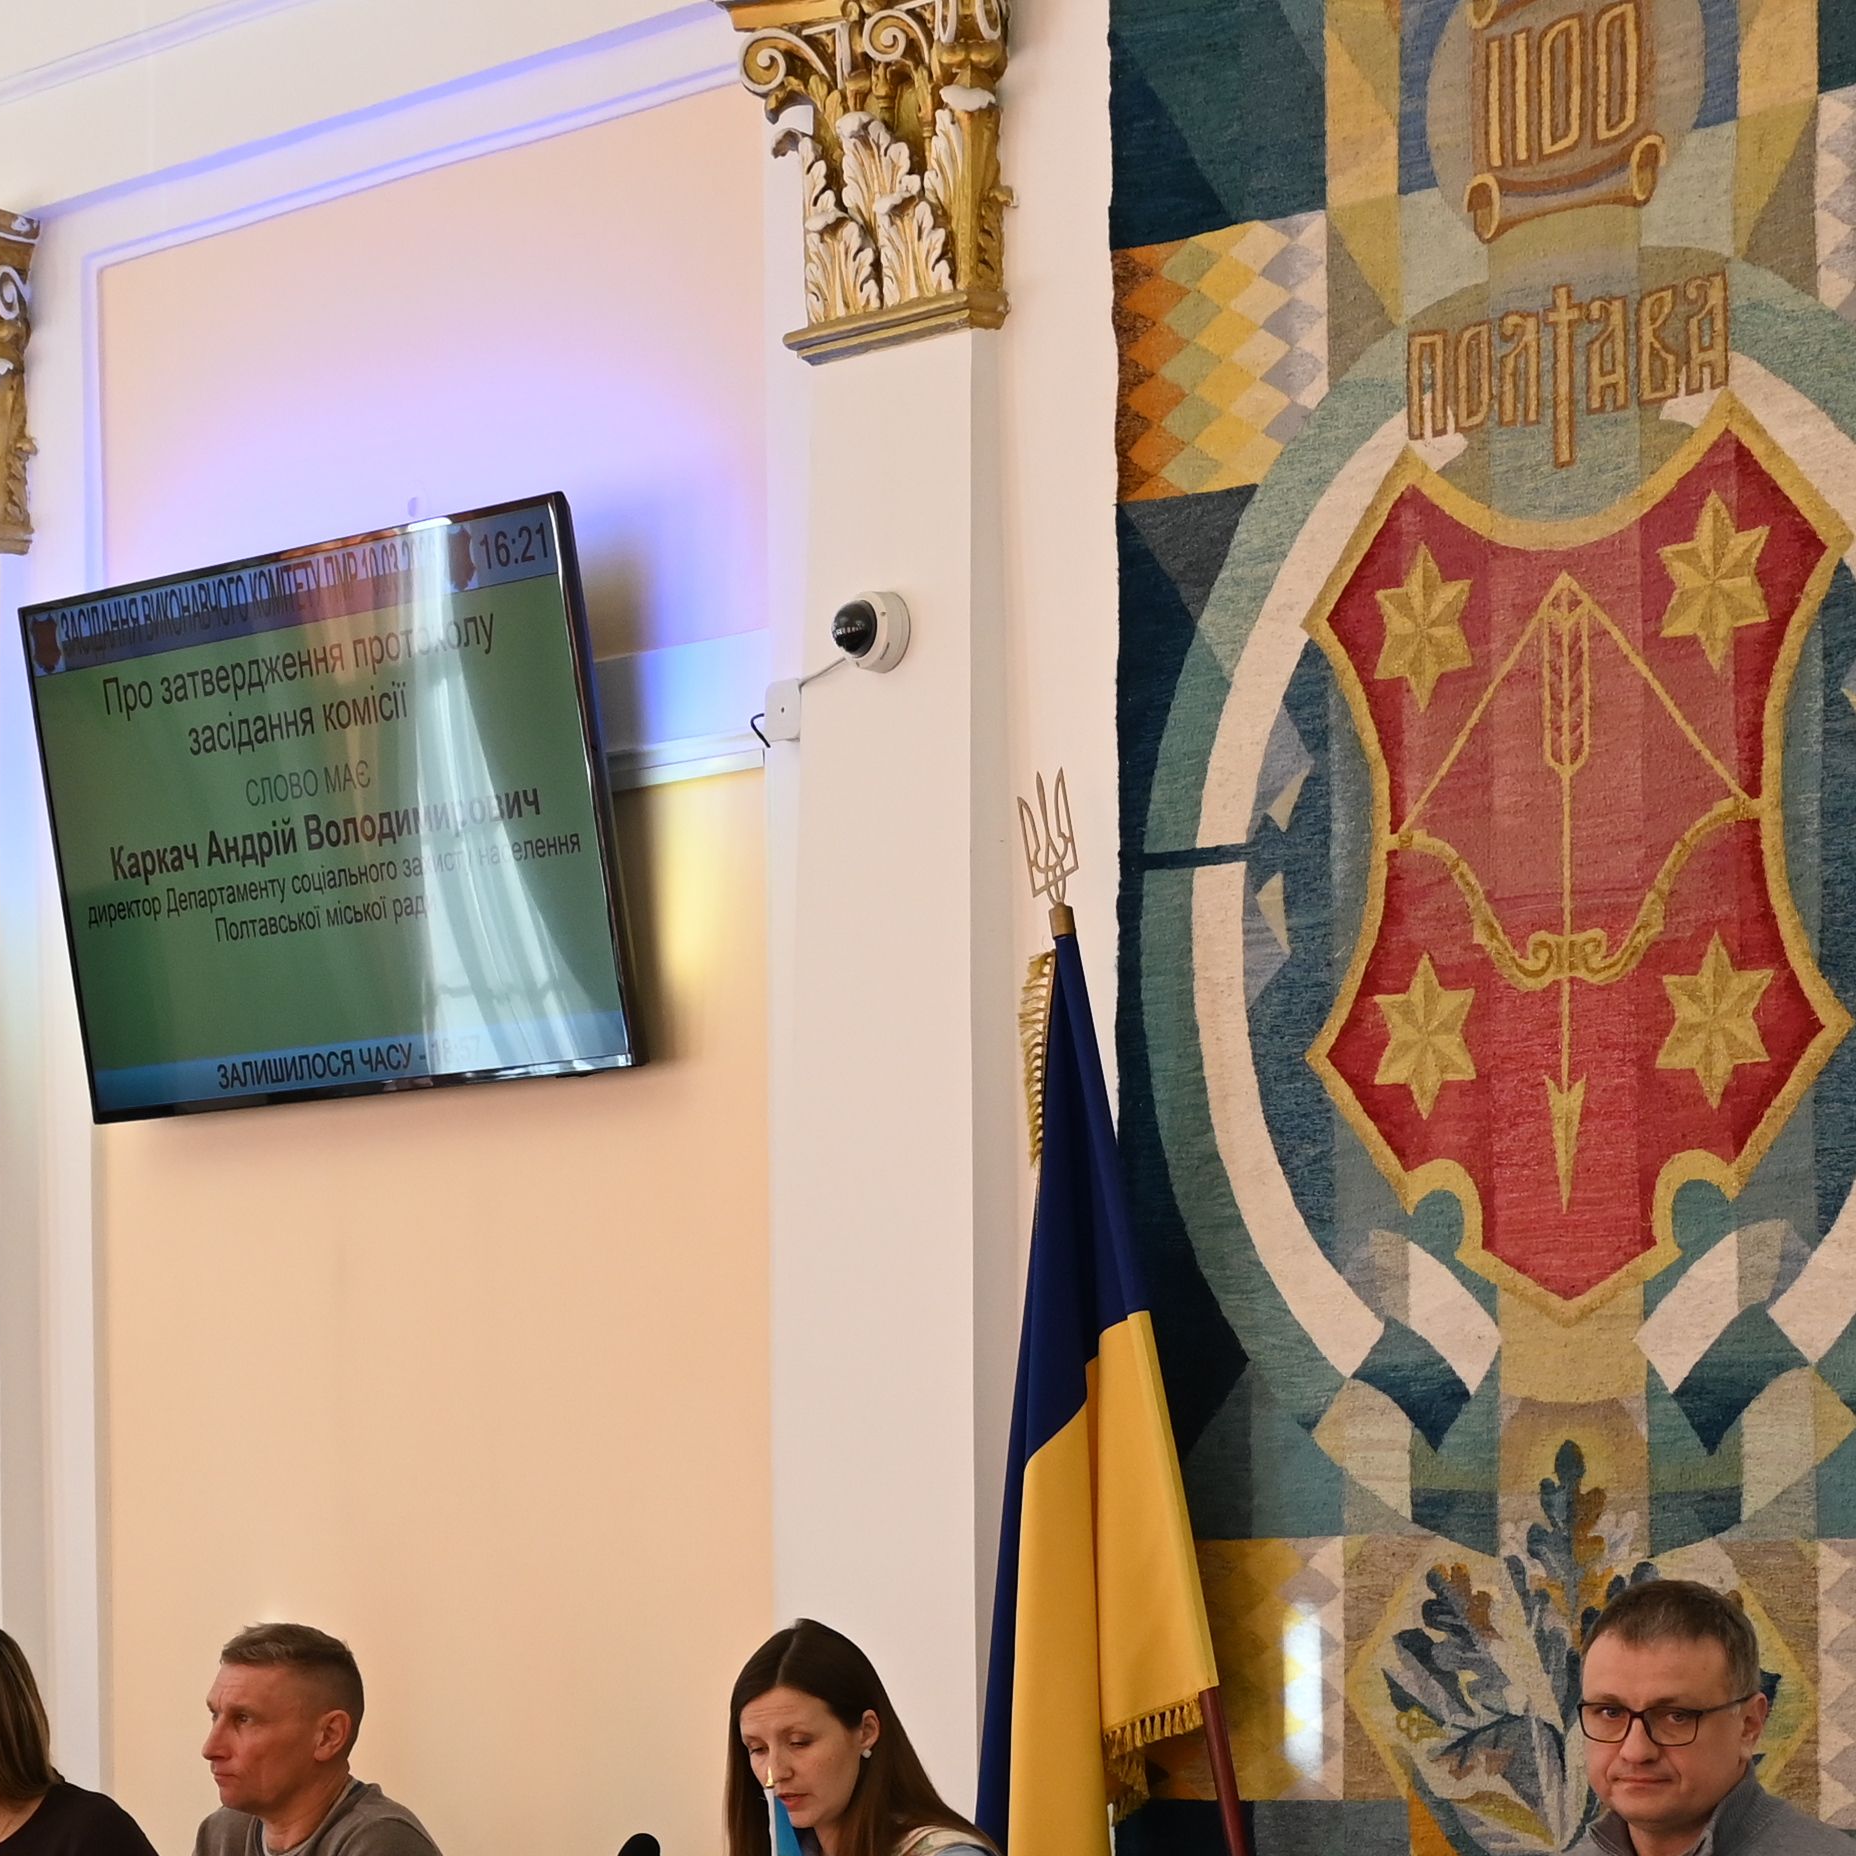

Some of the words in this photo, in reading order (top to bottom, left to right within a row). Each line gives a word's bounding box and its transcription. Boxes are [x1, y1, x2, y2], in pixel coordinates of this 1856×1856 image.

[479, 521, 549, 570] 16:21
[60, 597, 138, 658] ЗАСІДАННЯ
[144, 574, 248, 641] ВИКОНАВЧОГО
[250, 558, 321, 618] КОМІТЕТУ
[324, 551, 359, 602] ПМР
[103, 676, 153, 722] Про
[160, 642, 345, 704] затвердження
[188, 706, 315, 756] засідання
[322, 681, 408, 732] комісії
[245, 768, 318, 806] СЛОВО
[324, 759, 371, 795] МАЄ
[110, 842, 199, 885] Каркач
[207, 817, 297, 868] Андрій
[88, 896, 162, 929] директор
[166, 877, 286, 917] Департаменту
[291, 861, 398, 894] соціального
[215, 905, 321, 942] Полтавської
[325, 895, 387, 928] міської
[217, 1048, 355, 1090] ЗАЛИШИЛОСЯ
[359, 1042, 412, 1075] ЧАСУ
